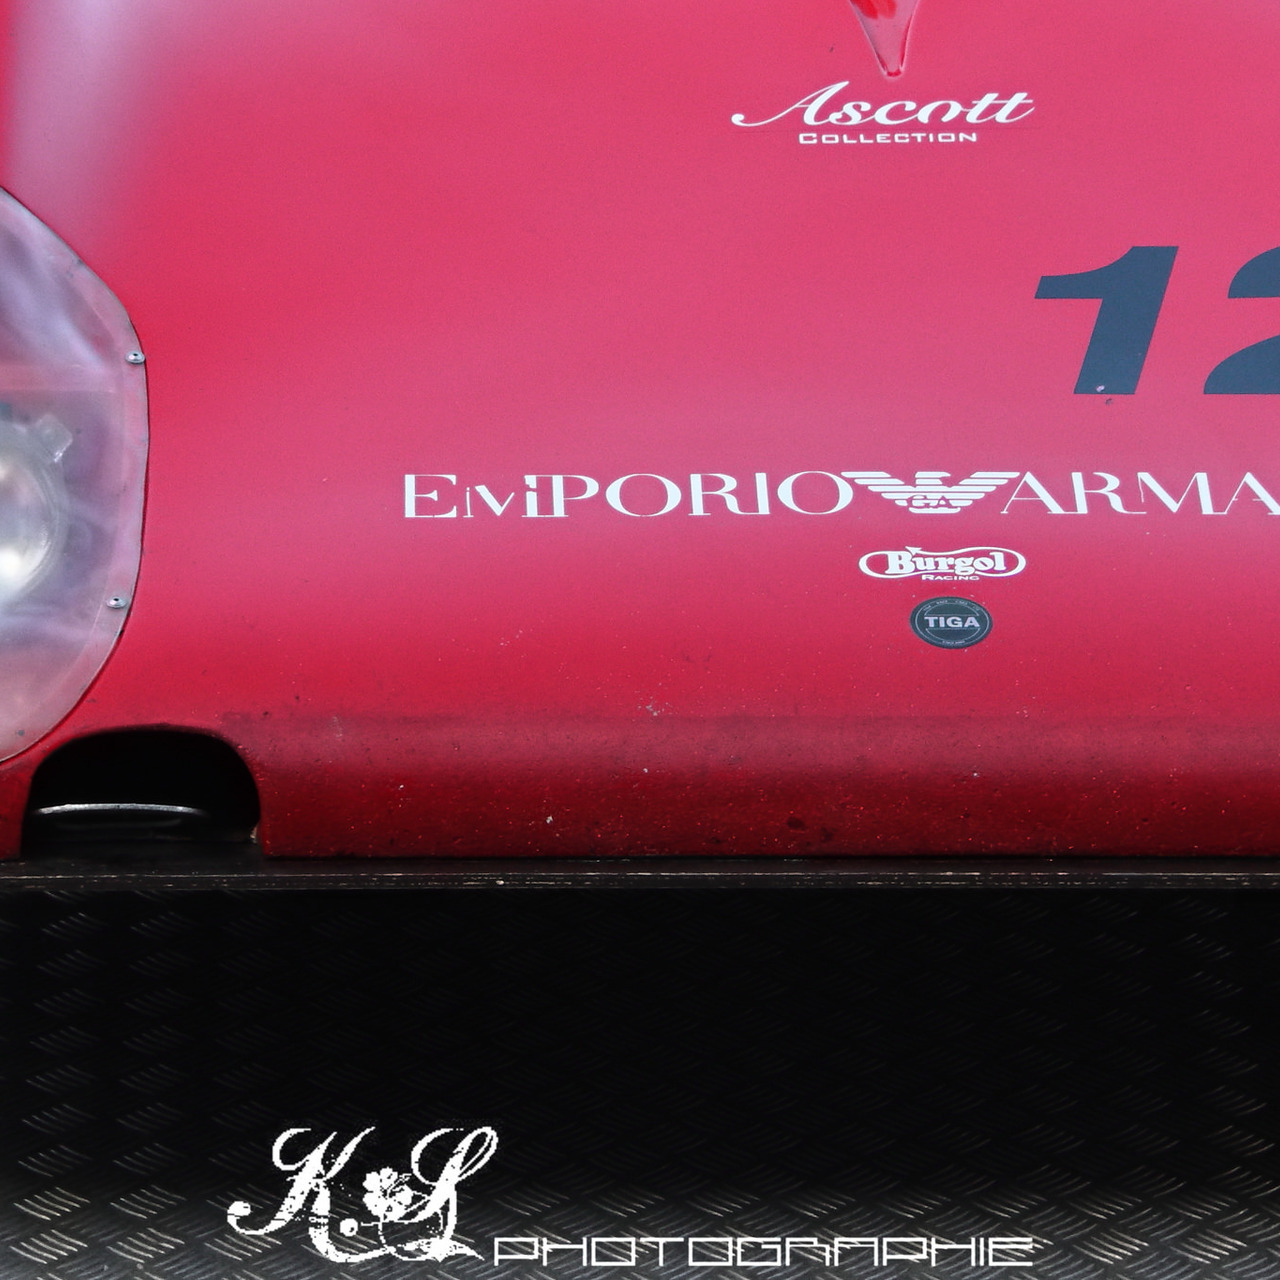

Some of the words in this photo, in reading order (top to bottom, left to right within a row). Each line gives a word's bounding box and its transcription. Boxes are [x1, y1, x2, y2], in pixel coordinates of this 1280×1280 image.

[730, 80, 1036, 127] Ascott
[884, 550, 1008, 576] Burgol
[923, 616, 981, 629] TIGA
